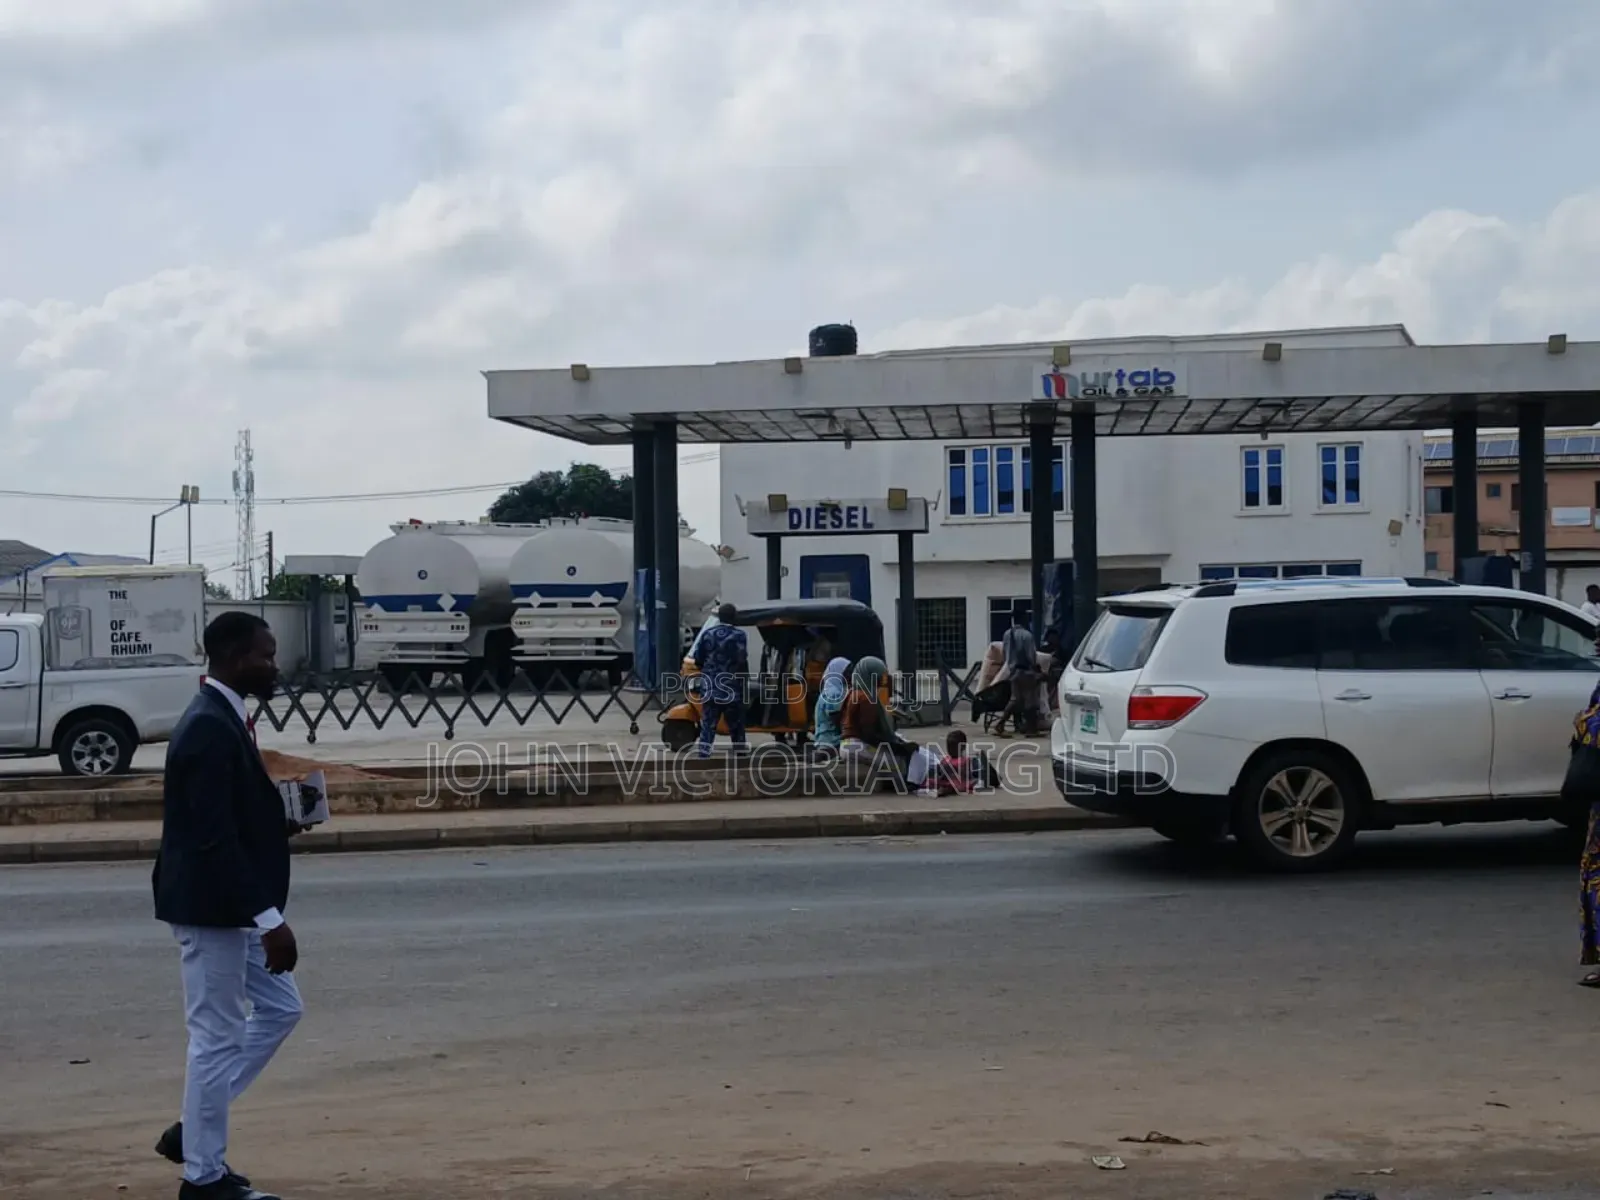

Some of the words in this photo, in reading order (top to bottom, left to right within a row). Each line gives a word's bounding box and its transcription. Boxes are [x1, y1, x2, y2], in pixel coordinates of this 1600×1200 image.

[1082, 387, 1112, 396] OIL
[1116, 387, 1129, 397] &
[1134, 386, 1174, 395] GAS
[788, 506, 874, 530] DIESEL
[109, 590, 127, 599] THE
[110, 620, 125, 630] OF
[111, 632, 141, 643] CAFE
[111, 643, 152, 656] RHUM!
